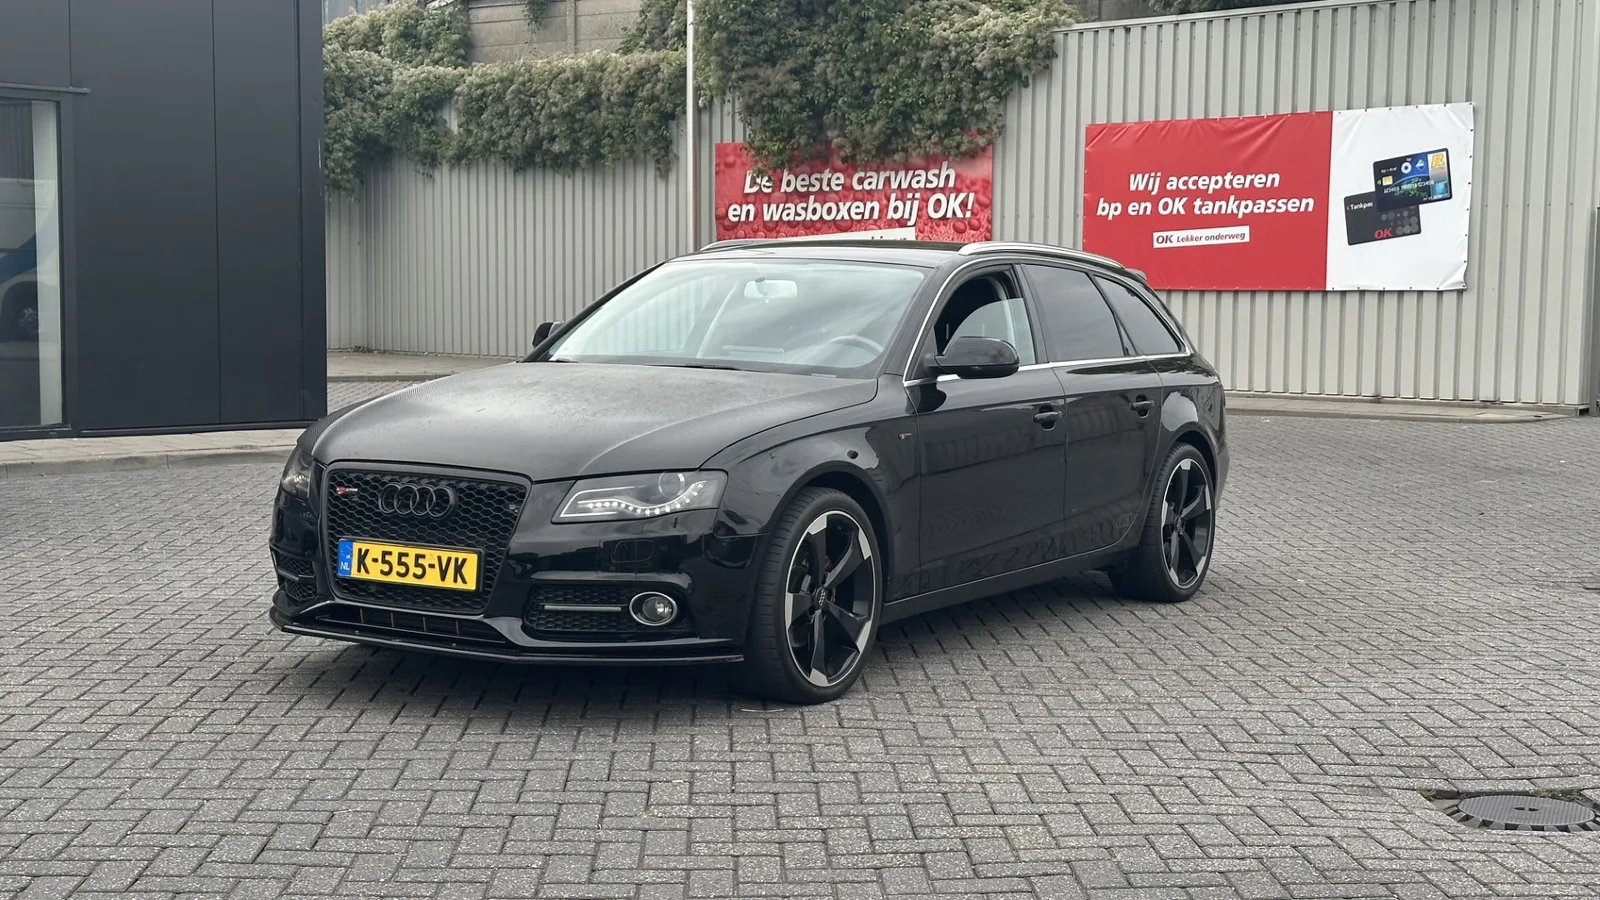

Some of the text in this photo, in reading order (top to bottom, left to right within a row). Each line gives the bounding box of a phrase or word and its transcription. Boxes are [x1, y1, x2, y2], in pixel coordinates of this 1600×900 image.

[743, 160, 956, 193] De beste carwash
[1128, 171, 1281, 195] Wij accepteren
[727, 191, 975, 226] en wasboxen bij OK!
[1096, 196, 1315, 220] bp en OK tankpassen
[1350, 201, 1373, 210] Tankpas
[1156, 231, 1246, 245] OK Lekker onderweg
[1374, 228, 1394, 239] OK
[340, 561, 350, 571] NL
[356, 547, 468, 585] K-555-VK
